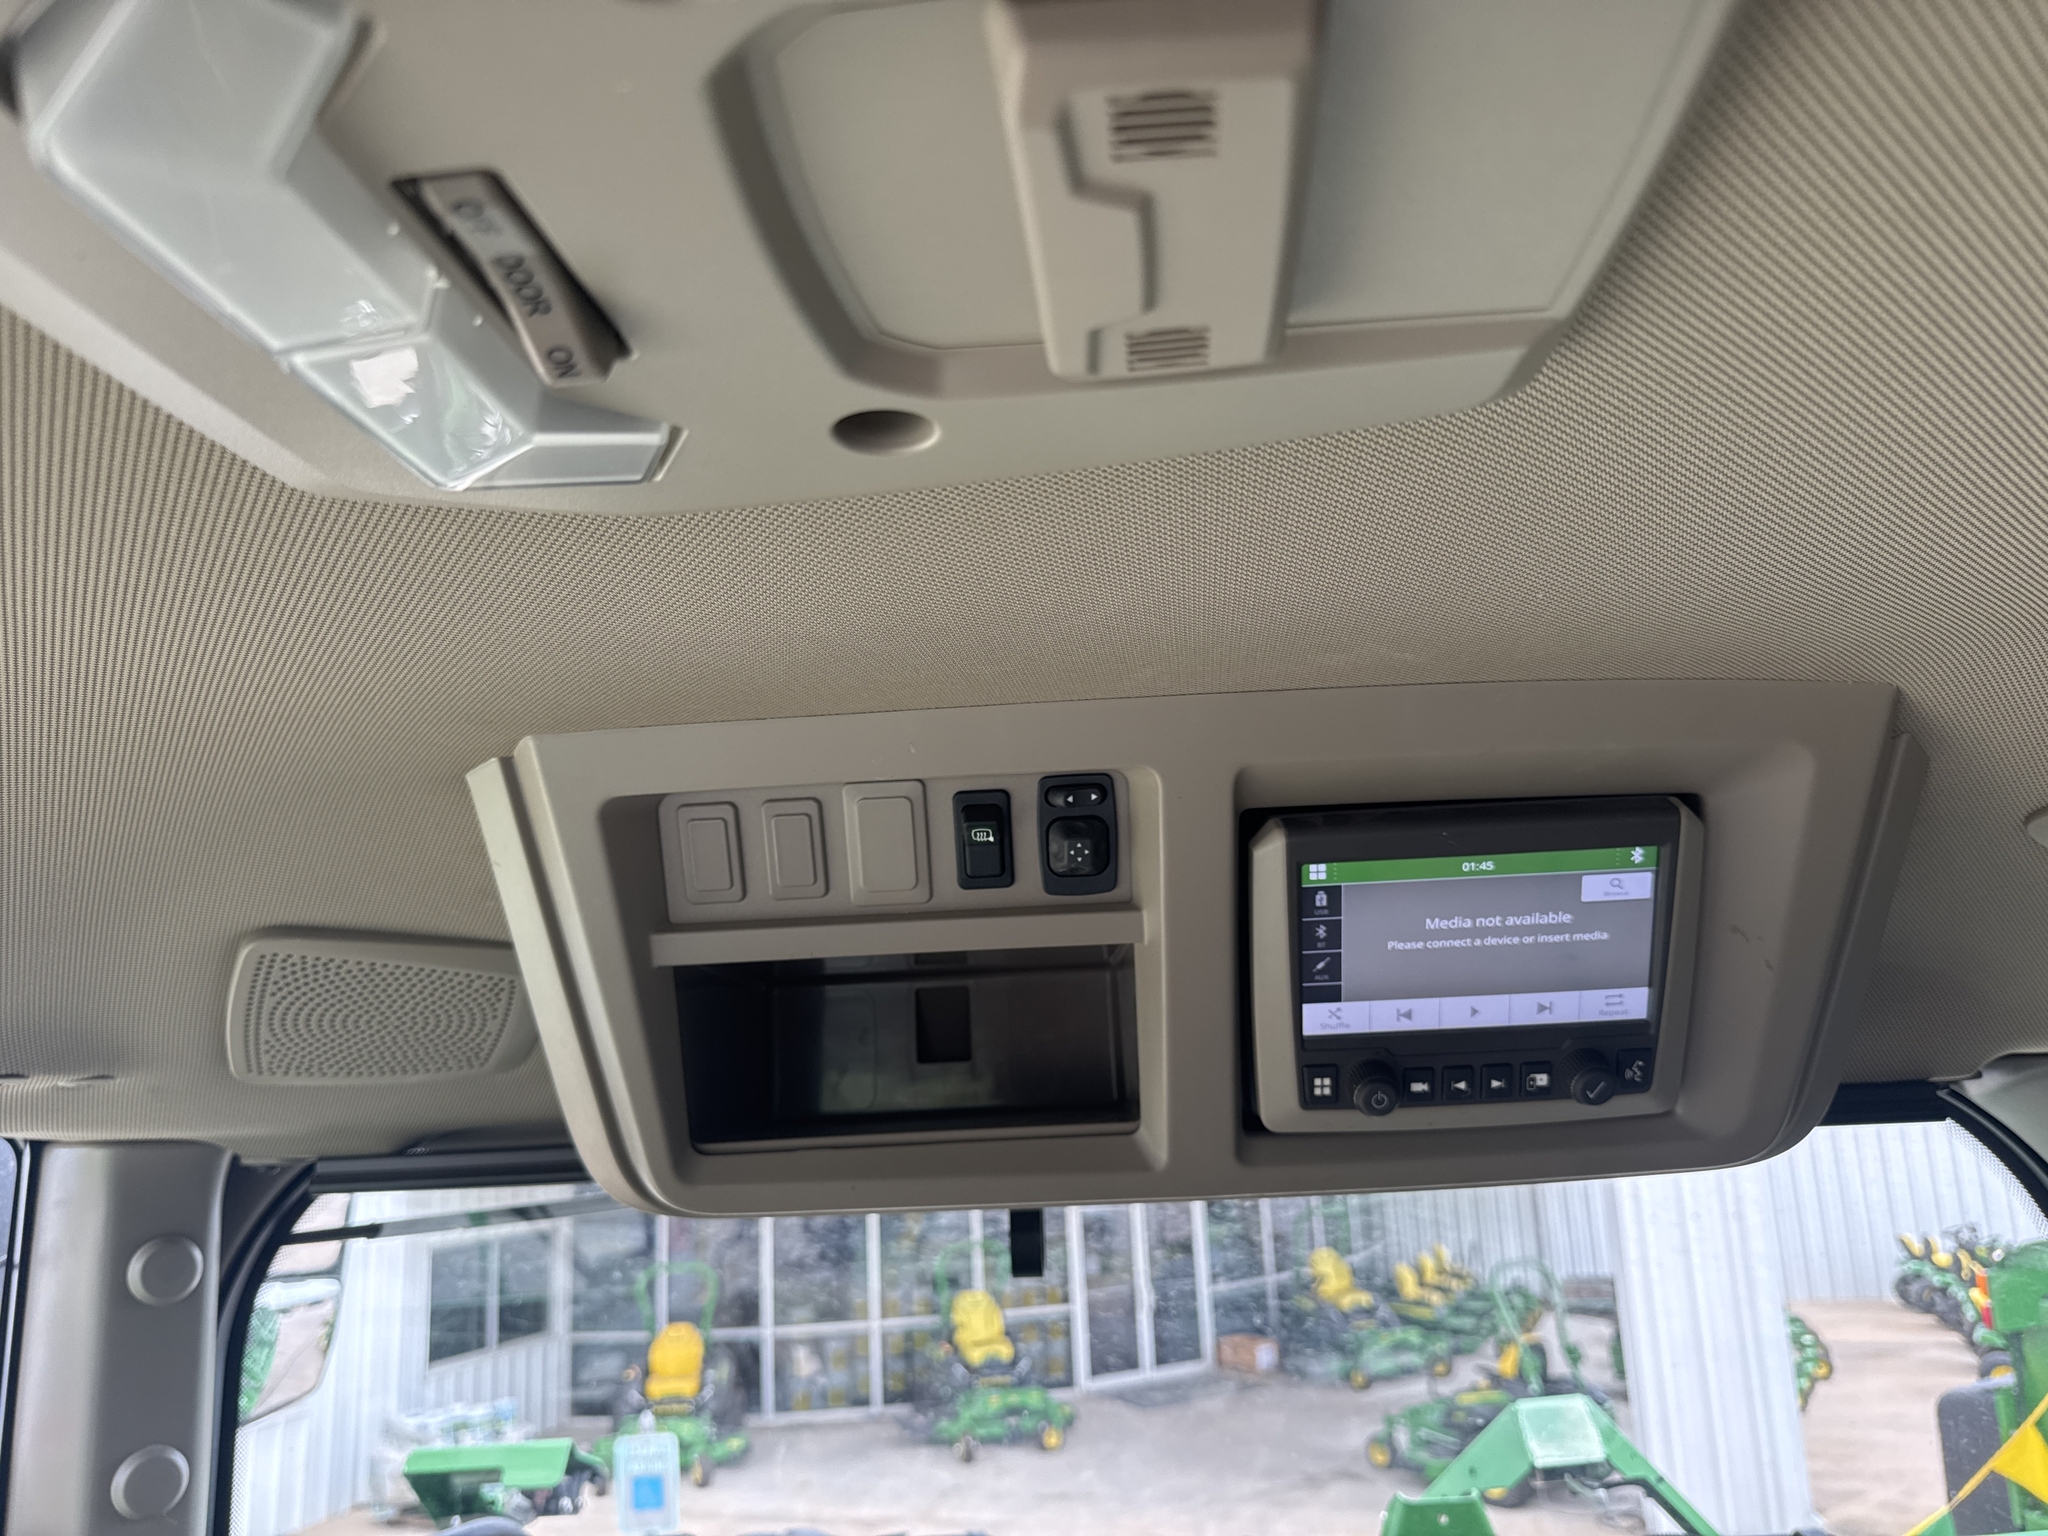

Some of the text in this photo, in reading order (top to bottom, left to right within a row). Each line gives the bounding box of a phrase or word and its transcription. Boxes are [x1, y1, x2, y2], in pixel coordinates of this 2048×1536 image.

[493, 254, 553, 318] DOOR
[547, 345, 582, 379] ON
[1461, 860, 1495, 872] 01:45
[1425, 911, 1573, 930] Media not available
[1387, 930, 1609, 951] Please connect a device or insert media
[1320, 1022, 1350, 1030] Shuffle
